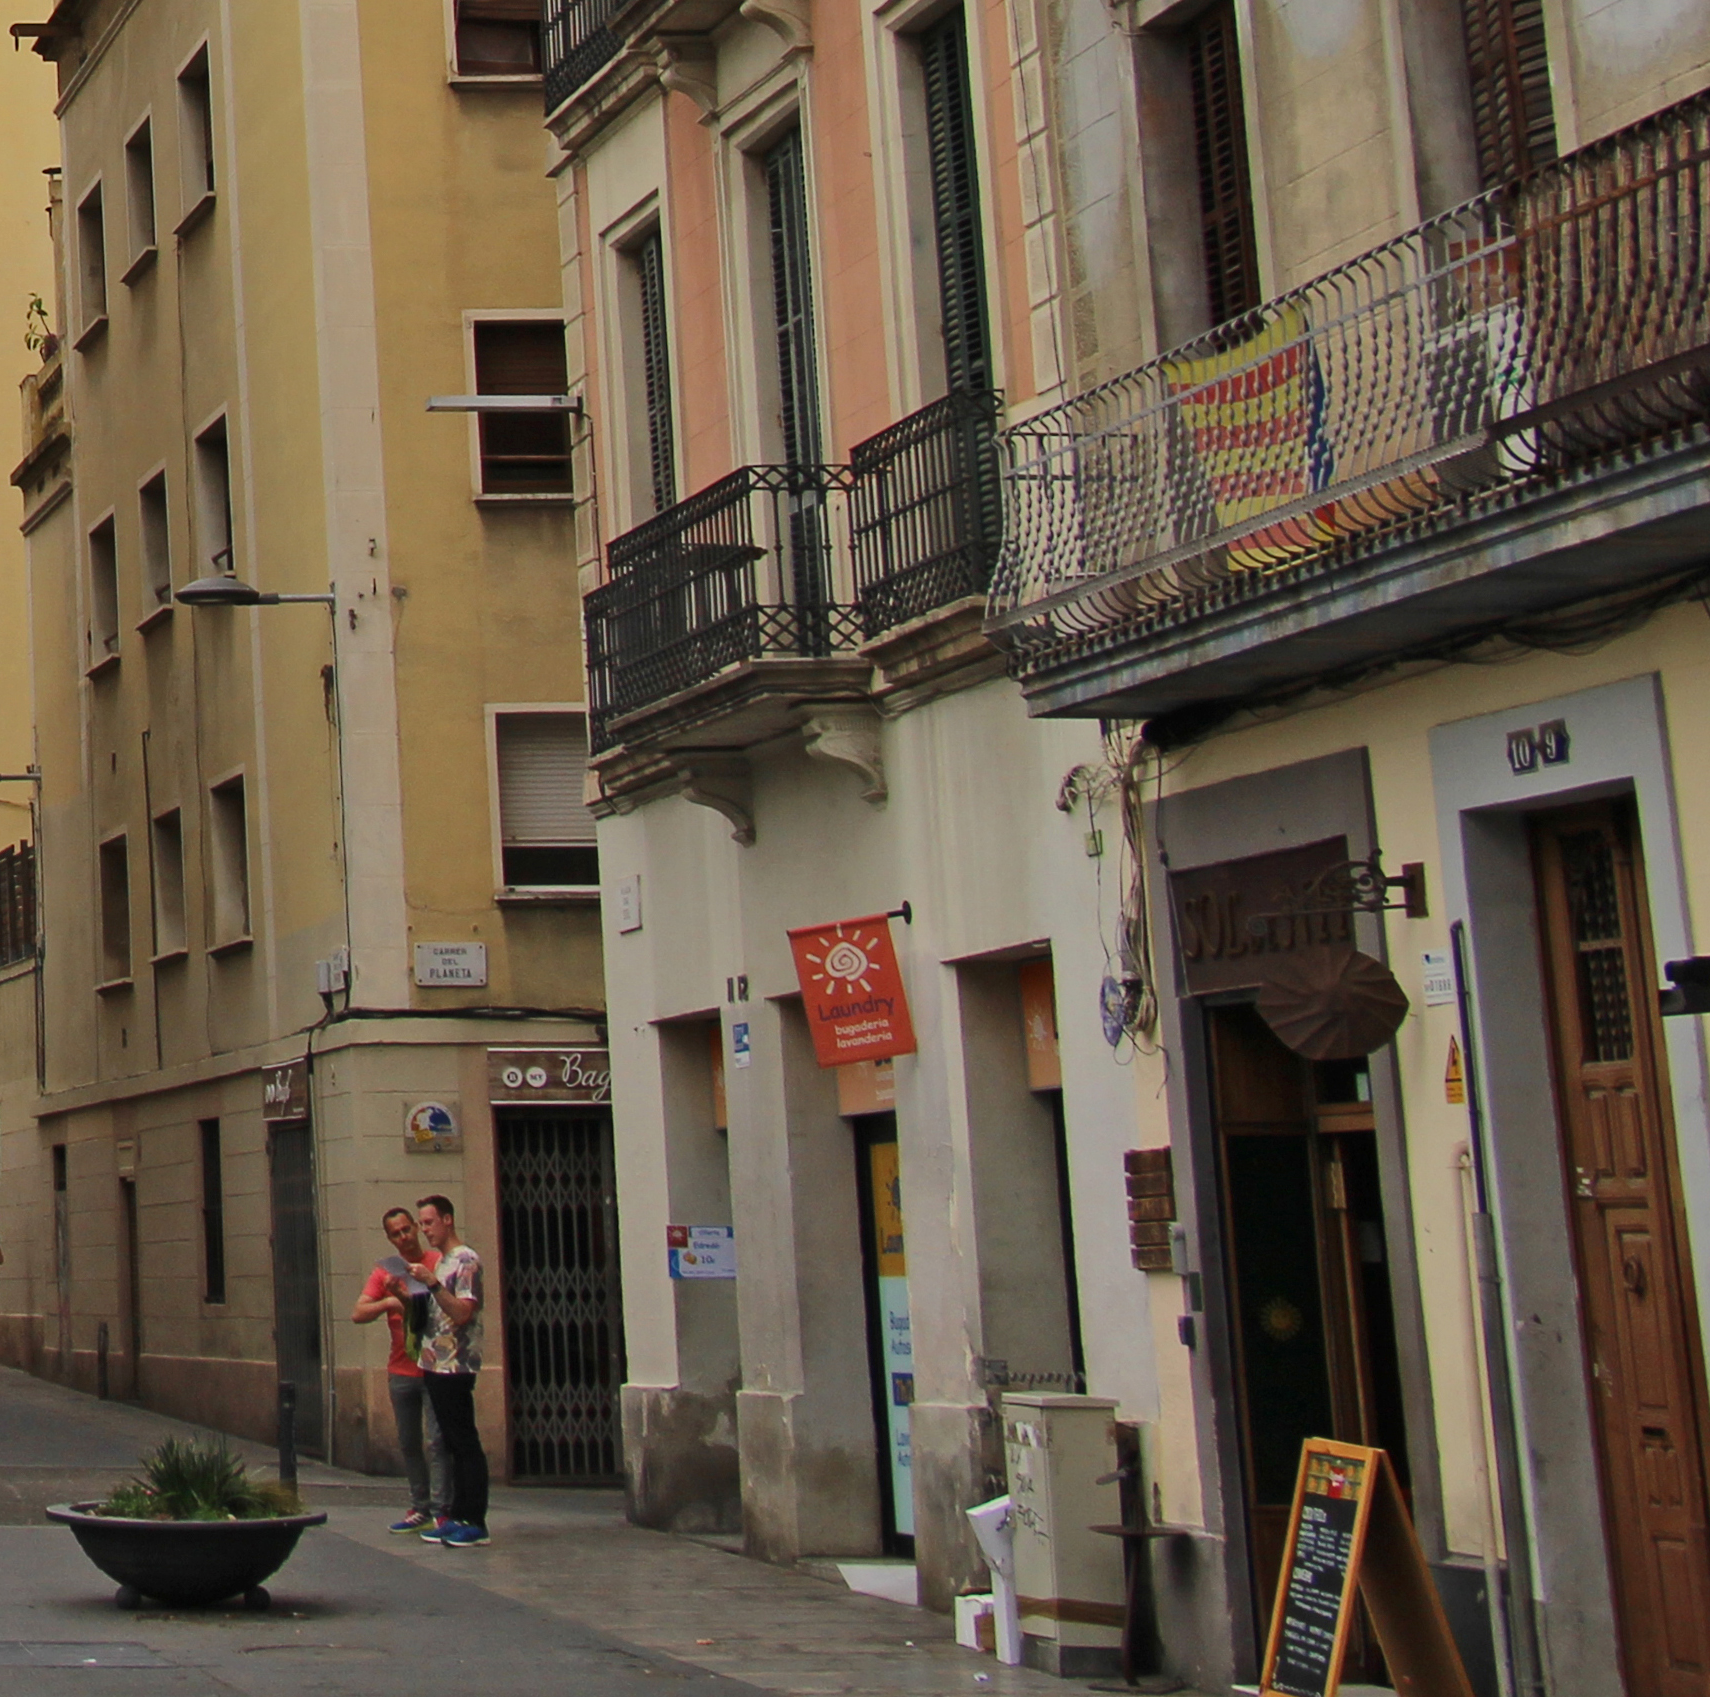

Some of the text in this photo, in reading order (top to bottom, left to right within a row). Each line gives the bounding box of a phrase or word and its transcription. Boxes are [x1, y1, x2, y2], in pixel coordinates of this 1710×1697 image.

[1512, 738, 1530, 769] 10
[1545, 728, 1556, 760] 9
[429, 968, 472, 978] PLANETA
[819, 996, 895, 1022] Laundry
[834, 1018, 890, 1036] bugaderia
[837, 1031, 893, 1049] lavanderia
